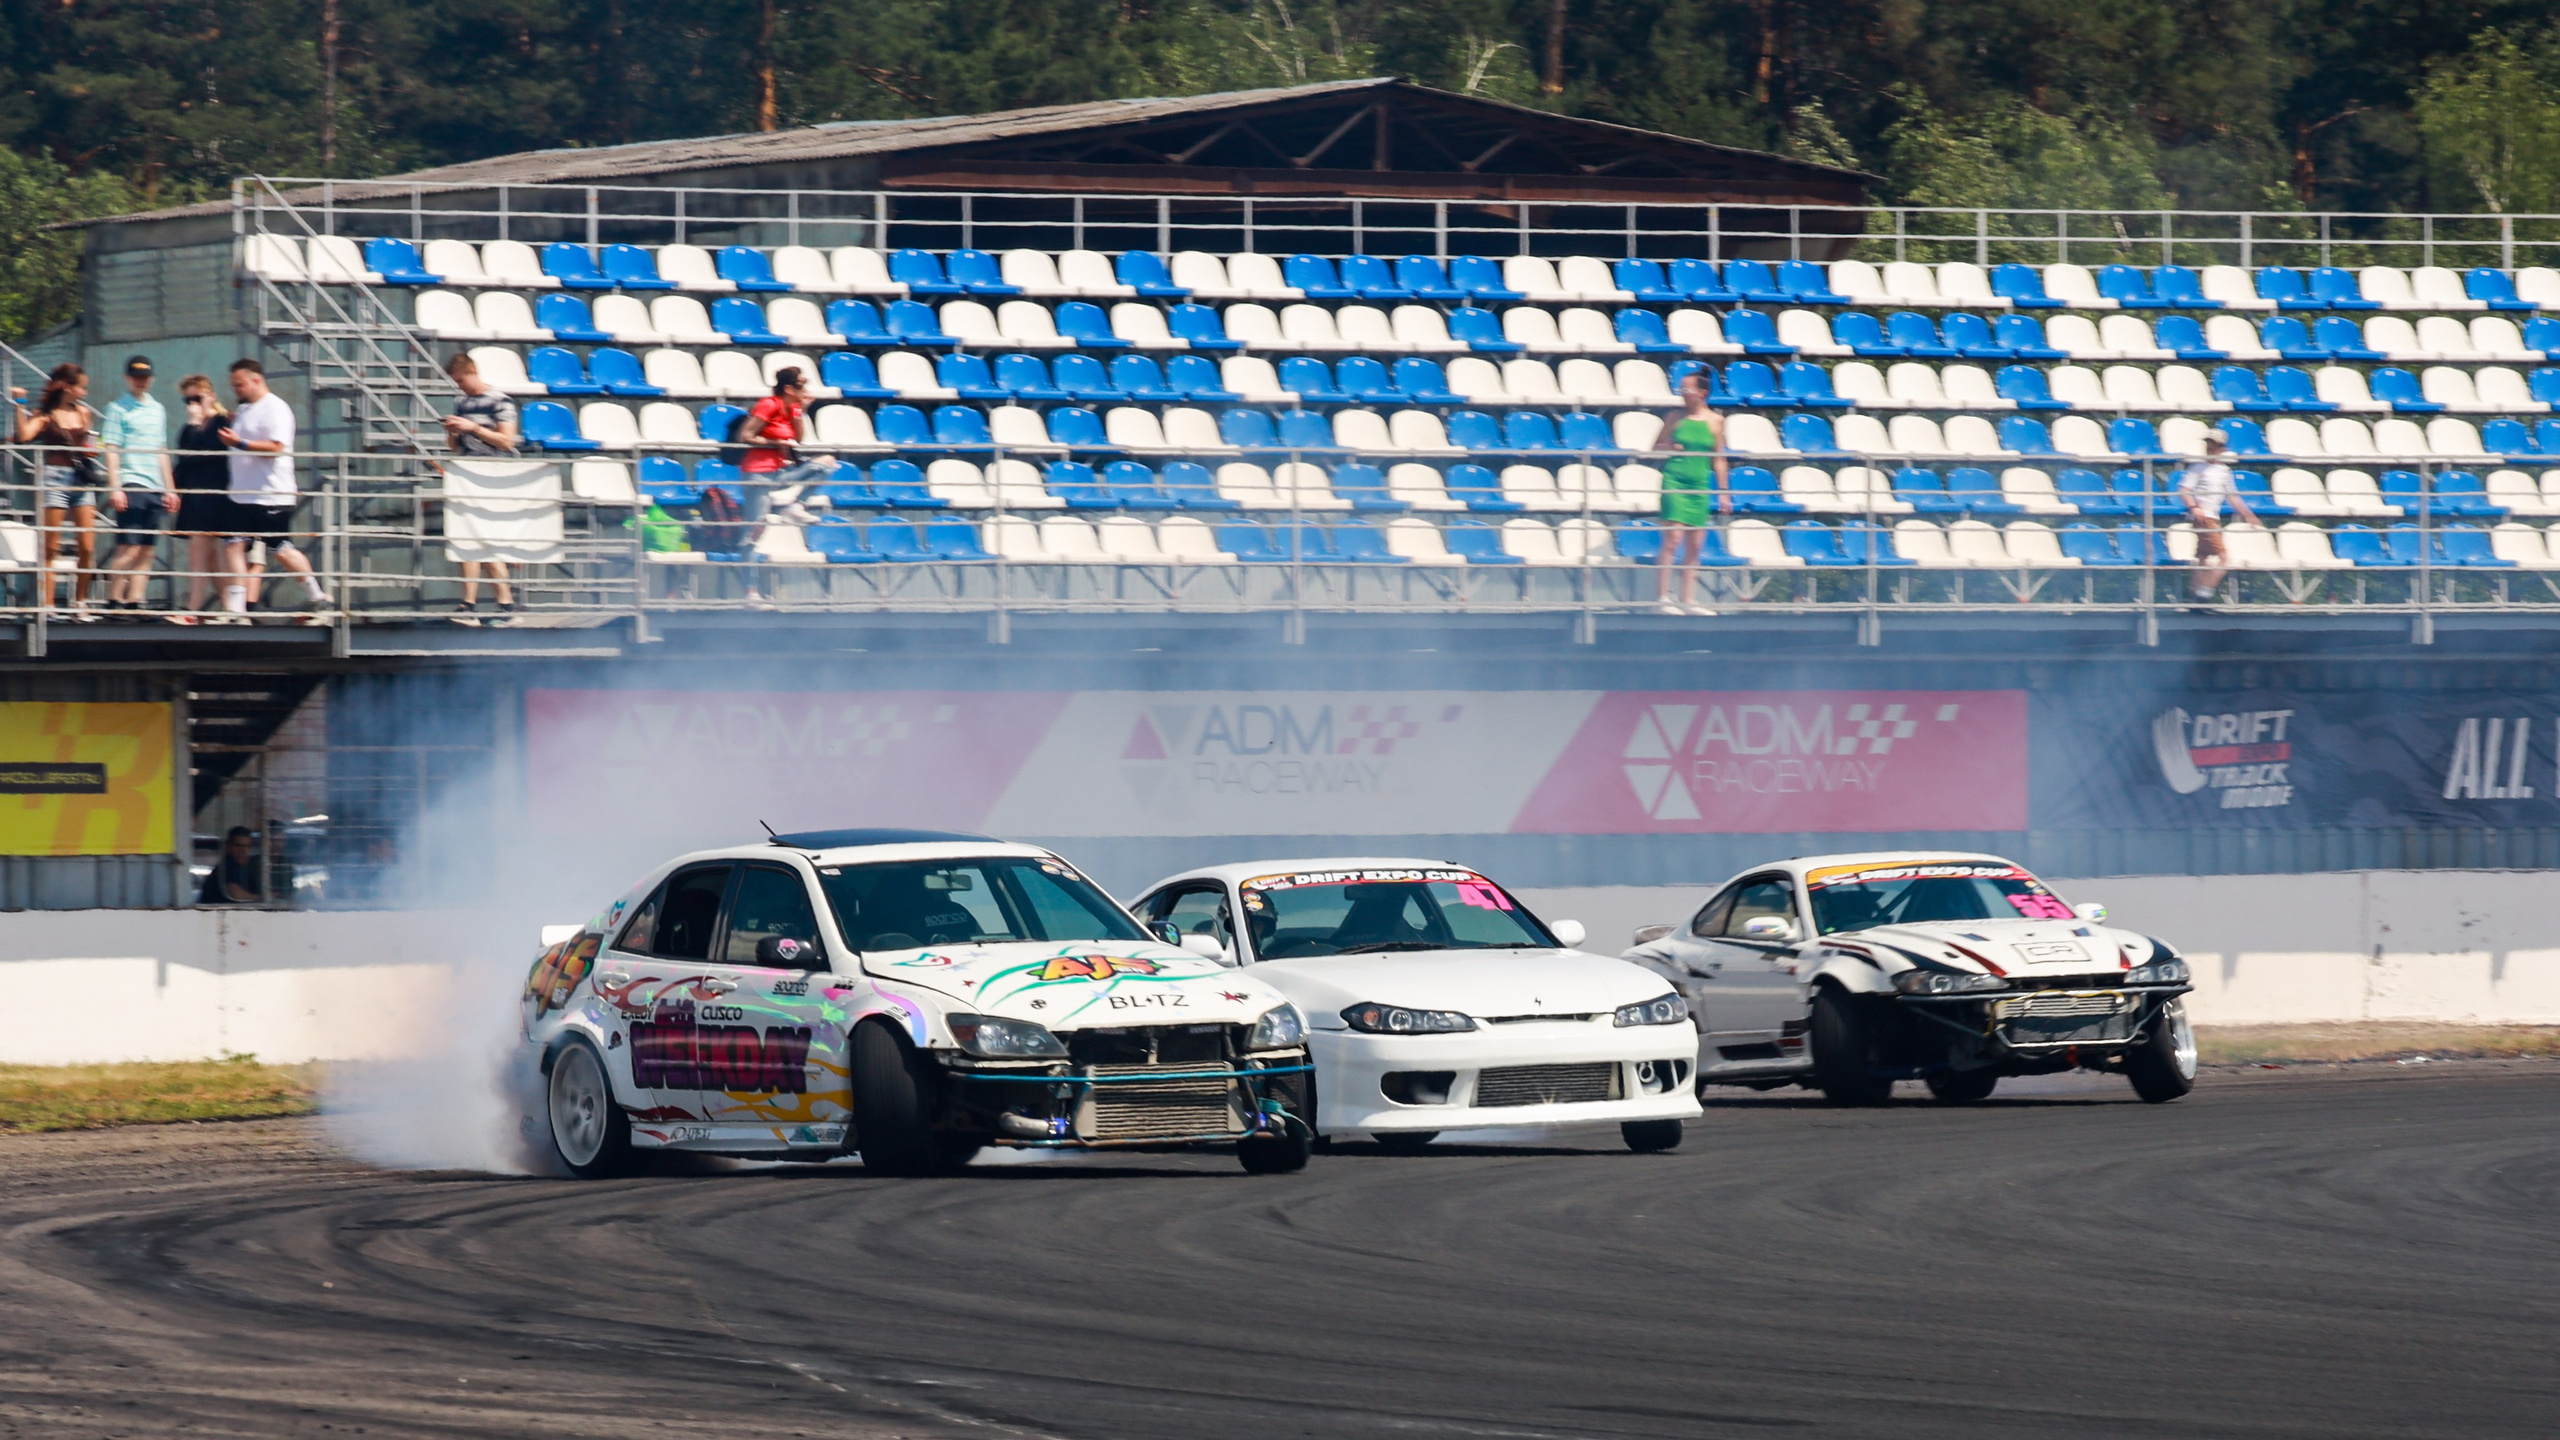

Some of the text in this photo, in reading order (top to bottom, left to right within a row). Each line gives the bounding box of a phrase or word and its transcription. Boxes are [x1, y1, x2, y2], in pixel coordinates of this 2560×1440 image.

[1193, 704, 1335, 755] ADM
[1693, 704, 1835, 755] ADM
[2192, 710, 2295, 746] DRIFT
[2443, 717, 2534, 799] ALL
[1193, 760, 1390, 793] RACEWAY
[1693, 759, 1886, 793] RACEWAY
[1294, 870, 1472, 885] DRIFT EXPO CUP
[1973, 867, 2014, 877] CUP
[1456, 884, 1513, 910] 47
[2007, 894, 2076, 919] 55
[701, 1006, 743, 1021] CUSCO
